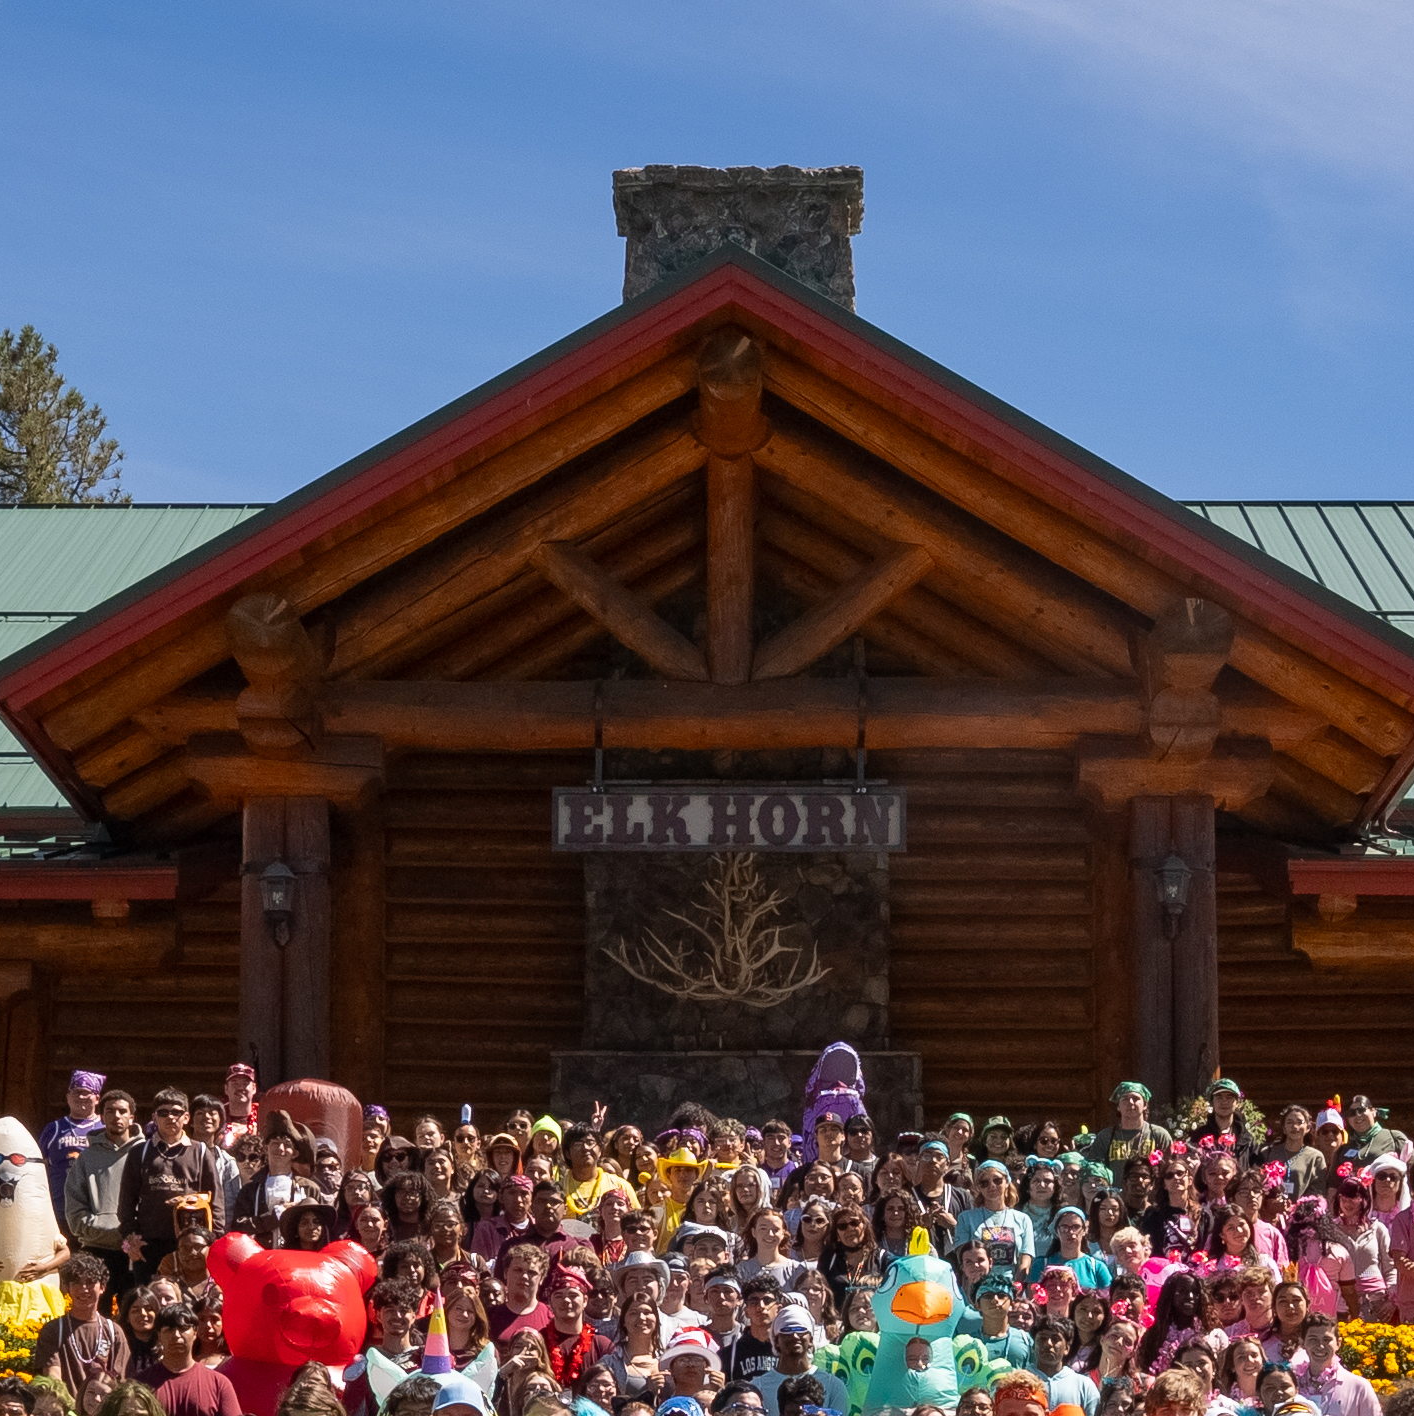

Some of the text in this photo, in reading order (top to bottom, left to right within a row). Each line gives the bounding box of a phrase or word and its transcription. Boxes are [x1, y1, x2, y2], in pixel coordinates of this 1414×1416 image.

[564, 795, 896, 844] ELK HORN
[740, 1356, 756, 1375] LOS
